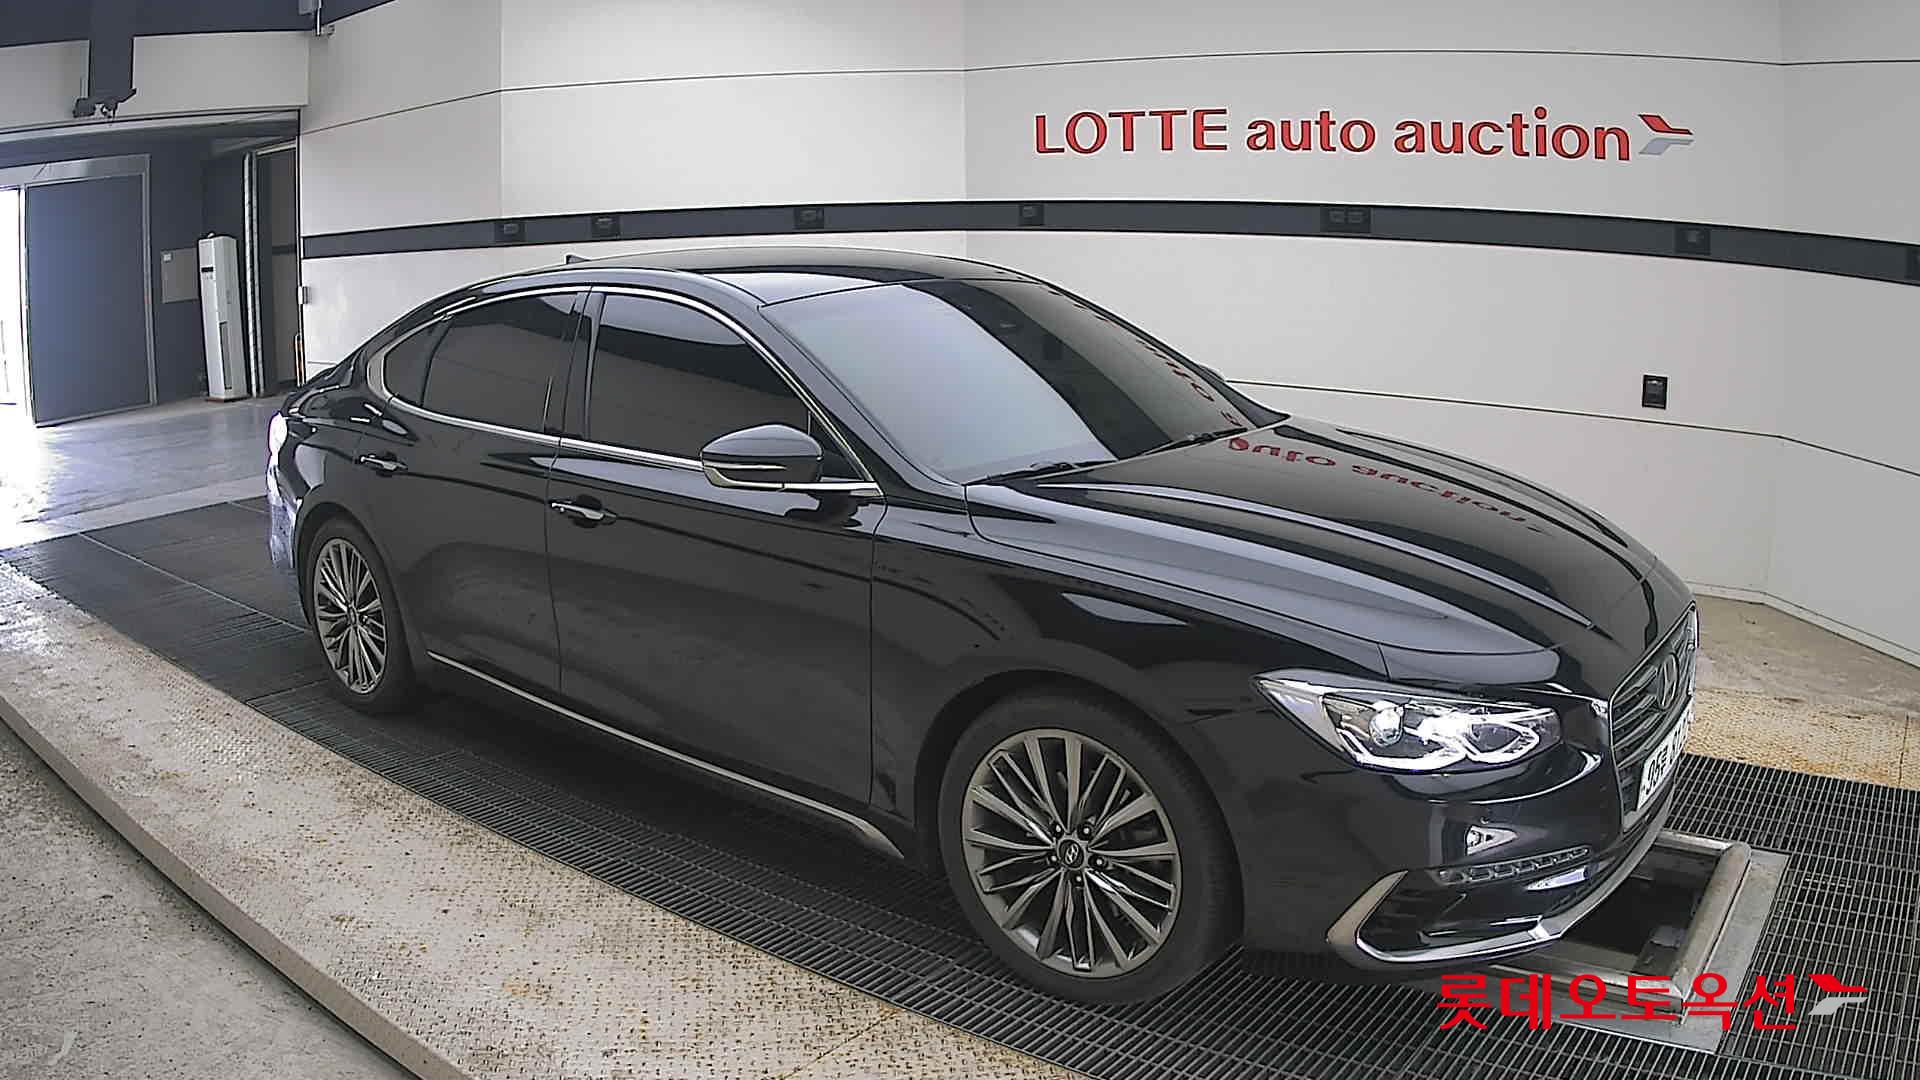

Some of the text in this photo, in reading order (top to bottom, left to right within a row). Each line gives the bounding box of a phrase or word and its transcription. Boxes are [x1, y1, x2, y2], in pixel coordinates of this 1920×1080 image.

[1034, 106, 1631, 161] LOTTE auto auction
